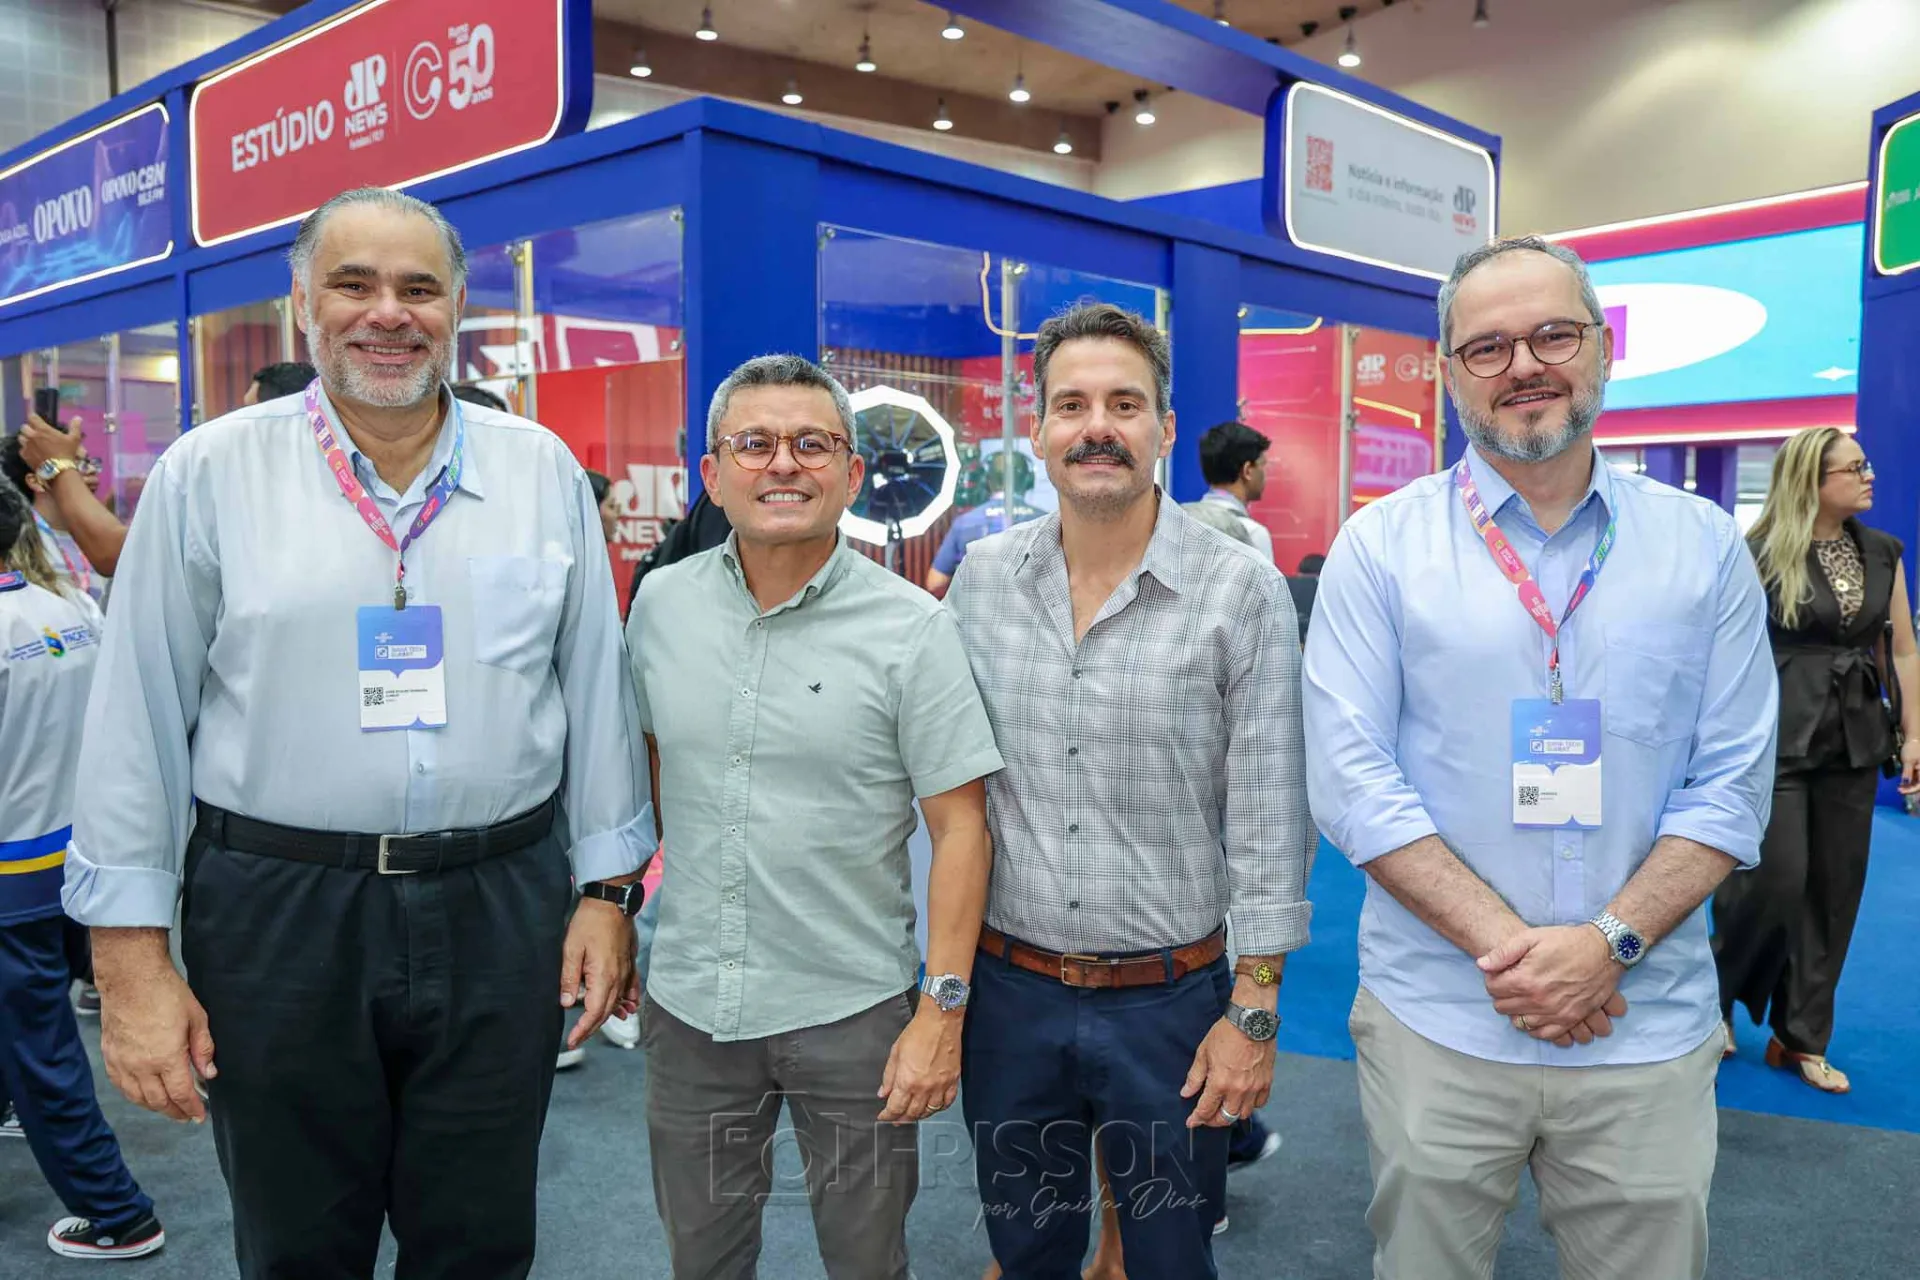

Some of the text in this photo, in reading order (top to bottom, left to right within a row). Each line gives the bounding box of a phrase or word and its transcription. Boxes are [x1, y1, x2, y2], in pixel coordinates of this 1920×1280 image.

[448, 23, 494, 110] 50
[231, 100, 335, 172] ESTÚDIO
[344, 102, 388, 137] NEWS
[137, 161, 166, 191] CBN
[1347, 163, 1382, 187] Notícia
